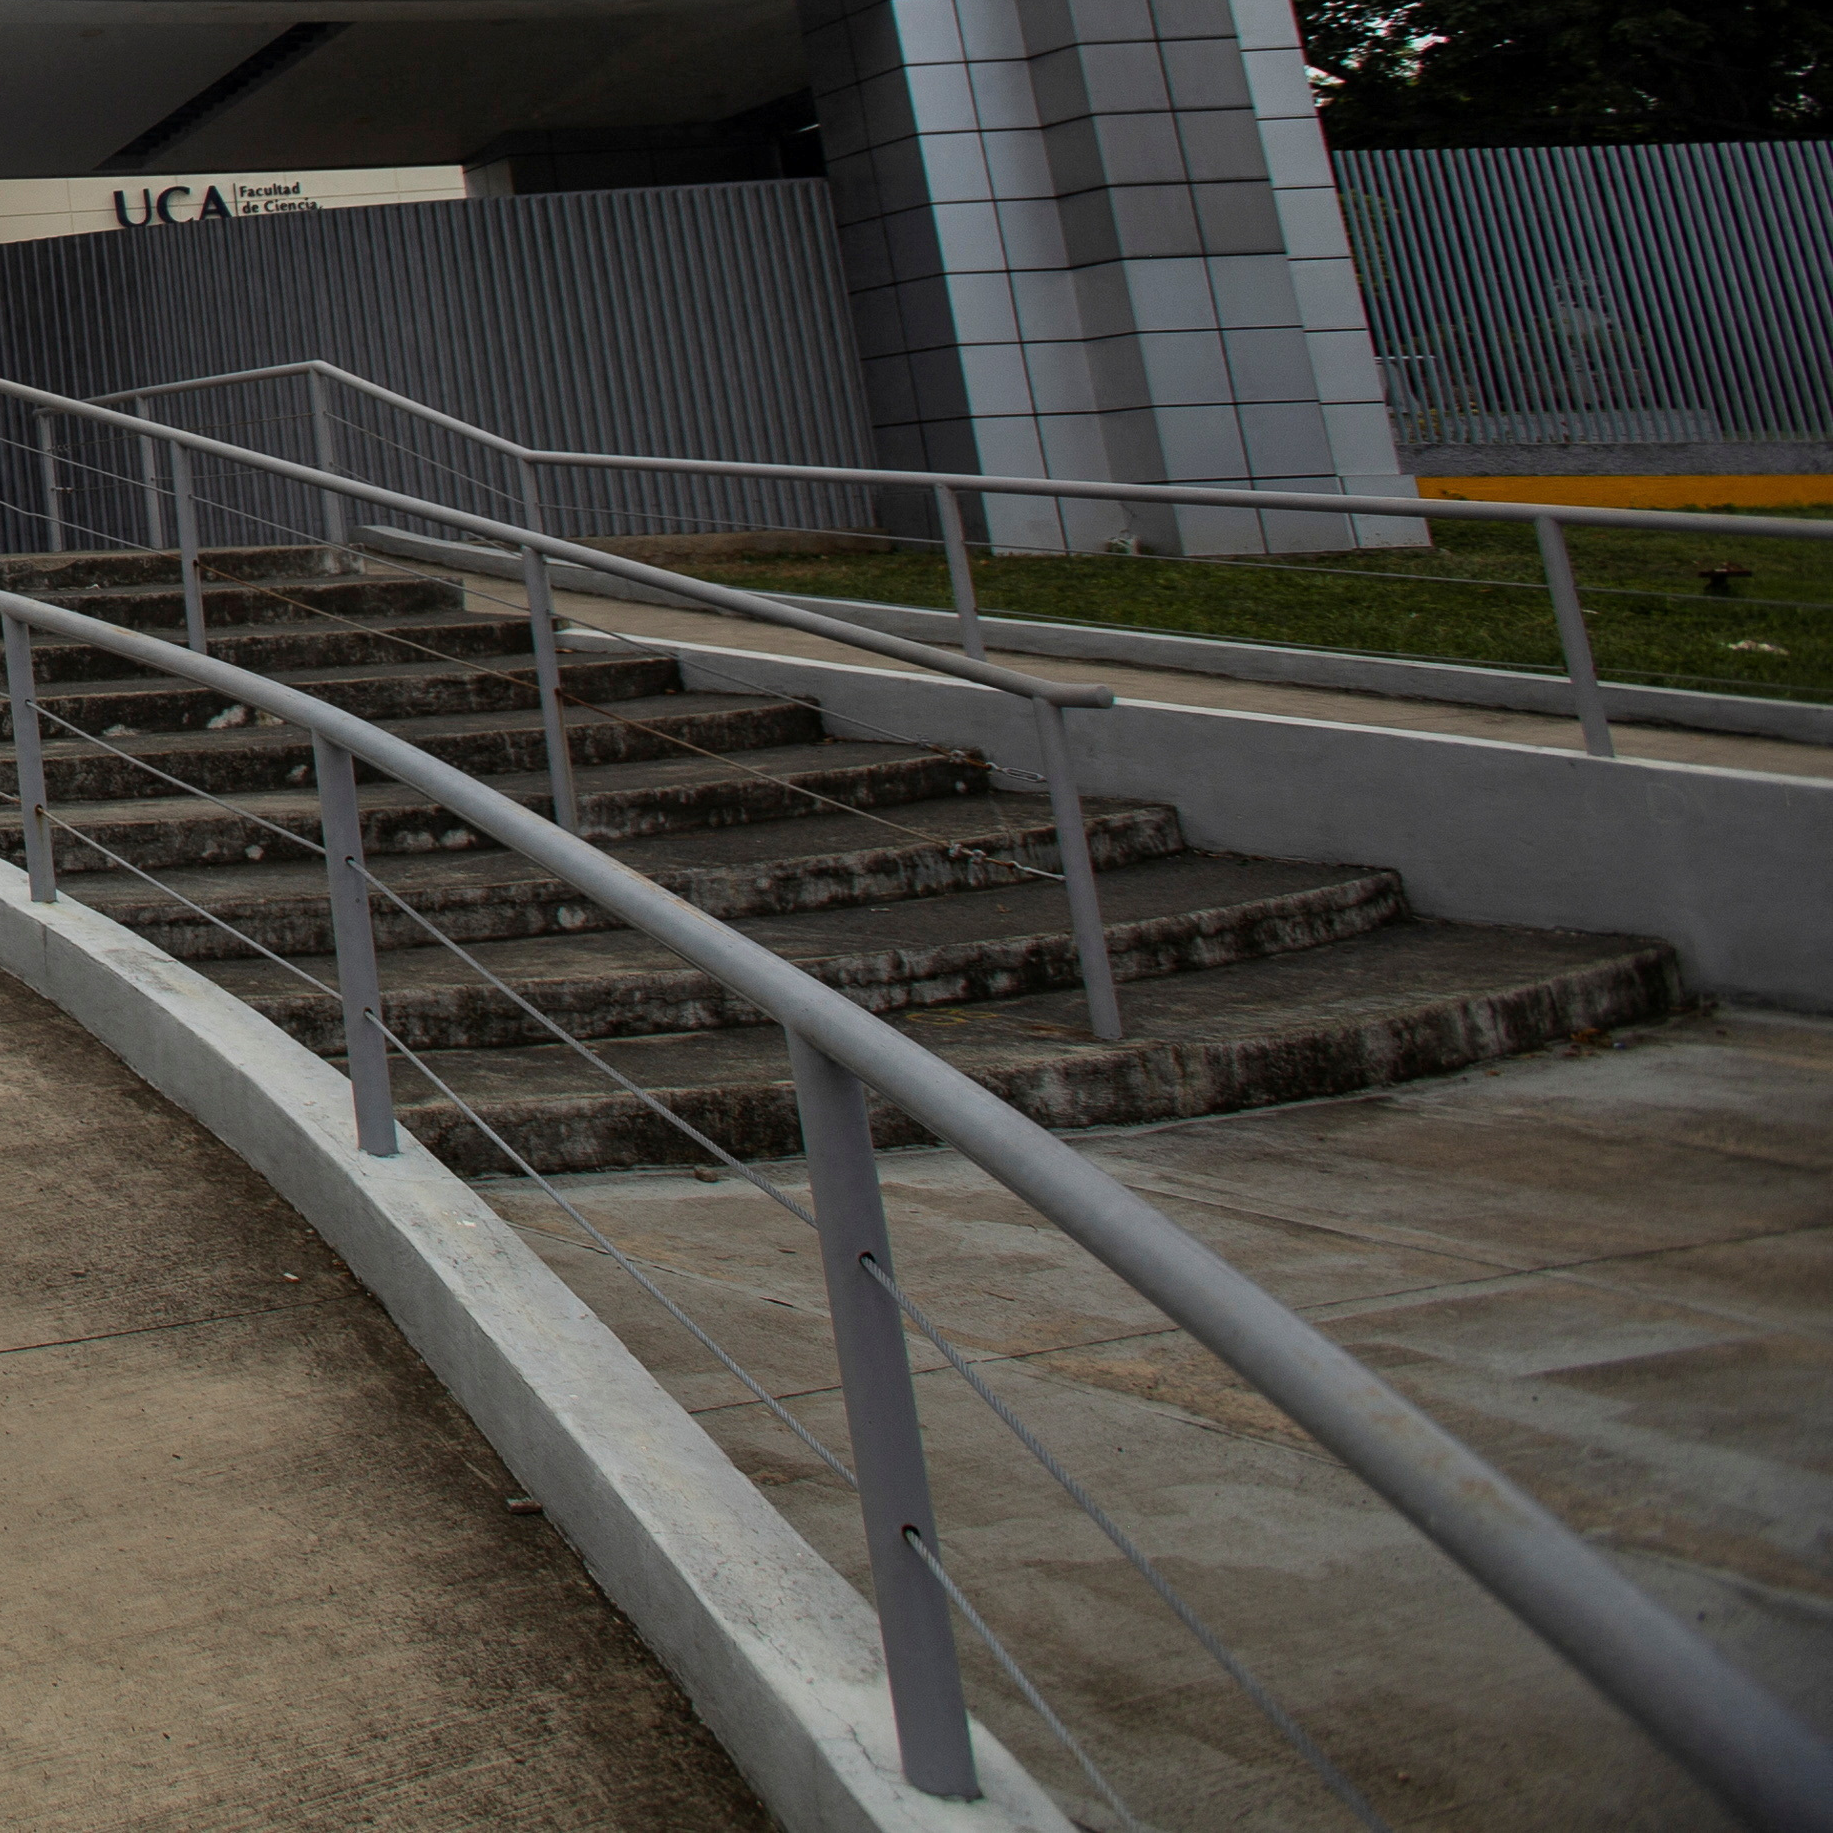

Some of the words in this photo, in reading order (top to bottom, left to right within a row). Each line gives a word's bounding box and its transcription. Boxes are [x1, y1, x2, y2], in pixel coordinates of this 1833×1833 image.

[239, 182, 301, 197] Facultad
[113, 185, 232, 228] UCA
[243, 201, 259, 214] de
[264, 198, 324, 213] Ciencia
